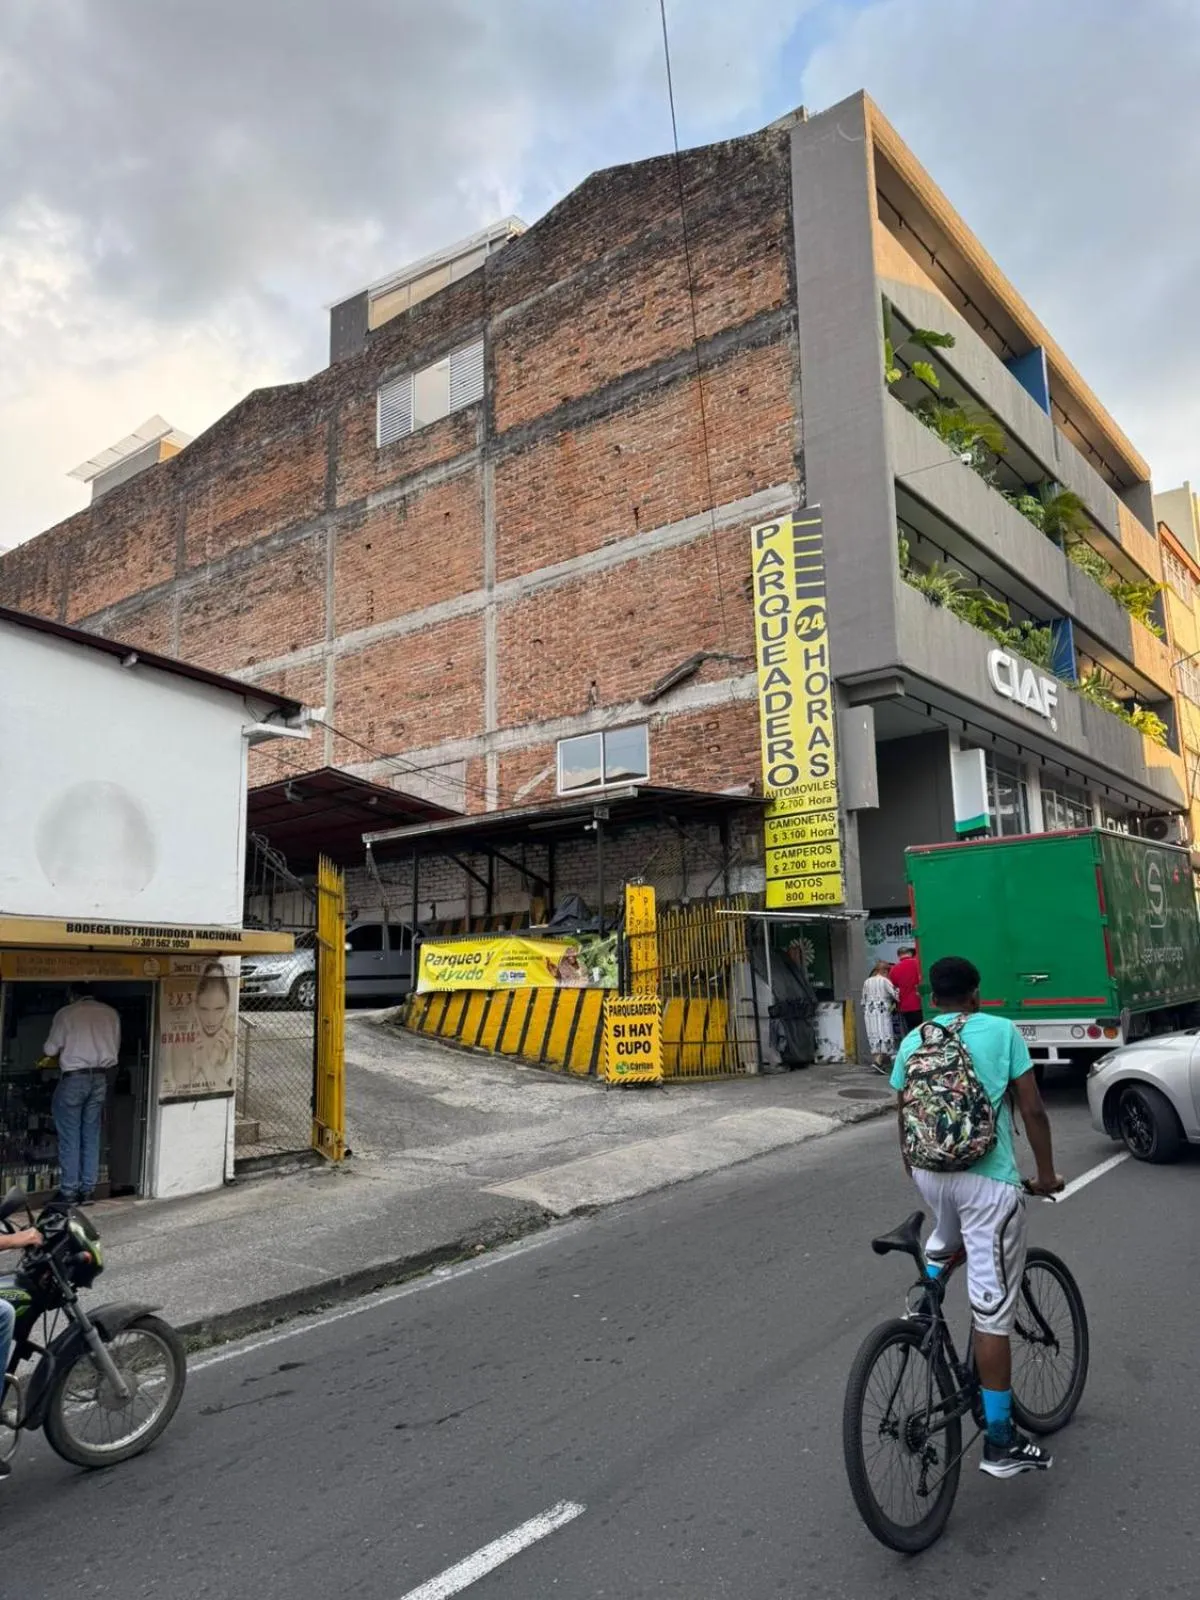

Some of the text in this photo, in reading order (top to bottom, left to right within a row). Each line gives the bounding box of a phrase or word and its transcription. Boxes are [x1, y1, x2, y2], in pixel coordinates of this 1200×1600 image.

[797, 612, 826, 636] 24
[756, 524, 799, 786] PARQUEADERO
[988, 649, 1057, 718] CIAF
[804, 644, 830, 777] HORAS
[765, 780, 838, 799] AUTOMOVILES
[780, 799, 804, 810] 2.700
[808, 796, 832, 806] Hora
[768, 812, 835, 831] CAMIONETAS
[782, 829, 806, 840] 3.100
[810, 827, 834, 838] Hora
[773, 844, 832, 860] CAMPEROS
[782, 860, 807, 871] 2.700
[812, 859, 836, 869] Hora
[784, 878, 823, 889] MOTOS
[786, 891, 835, 902] 800 Hora
[66, 922, 242, 942] BODEGA DISTRIBUIDORA NACIONAL
[425, 952, 482, 968] Parqueo
[436, 965, 484, 981] Ayudo
[608, 1003, 657, 1017] PARQUEADERO
[613, 1022, 653, 1038] SI HAY
[616, 1041, 651, 1055] CUPO
